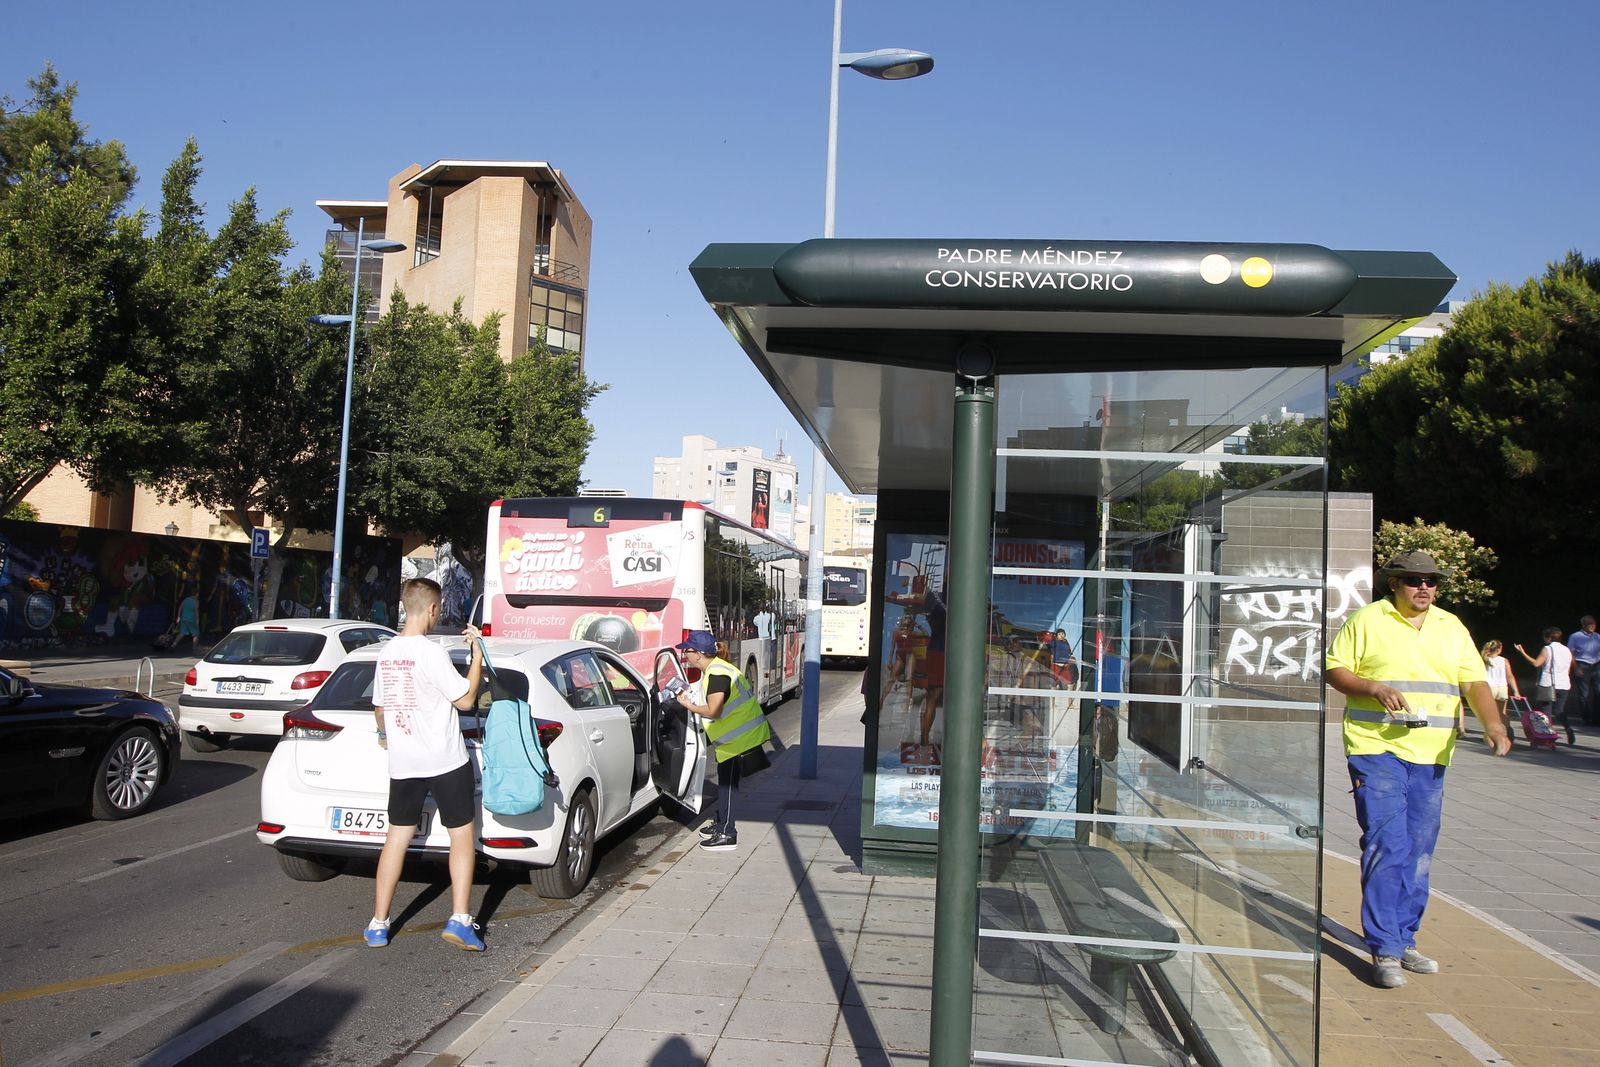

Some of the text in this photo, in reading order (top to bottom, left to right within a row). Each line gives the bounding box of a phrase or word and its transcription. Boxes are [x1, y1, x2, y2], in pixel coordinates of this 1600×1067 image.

[937, 246, 1123, 267] PADRE MÉNDEZ
[925, 269, 1133, 292] CONSERVATORIO
[255, 532, 265, 553] P
[624, 538, 653, 549] Reina
[630, 549, 639, 557] de
[622, 556, 662, 573] CASI
[677, 587, 697, 596] 3168
[502, 612, 566, 626] Con nuestra
[222, 682, 242, 691] 4433
[911, 782, 940, 791] LAS PLAY
[343, 811, 385, 830] 8475
[928, 811, 939, 822] 16
